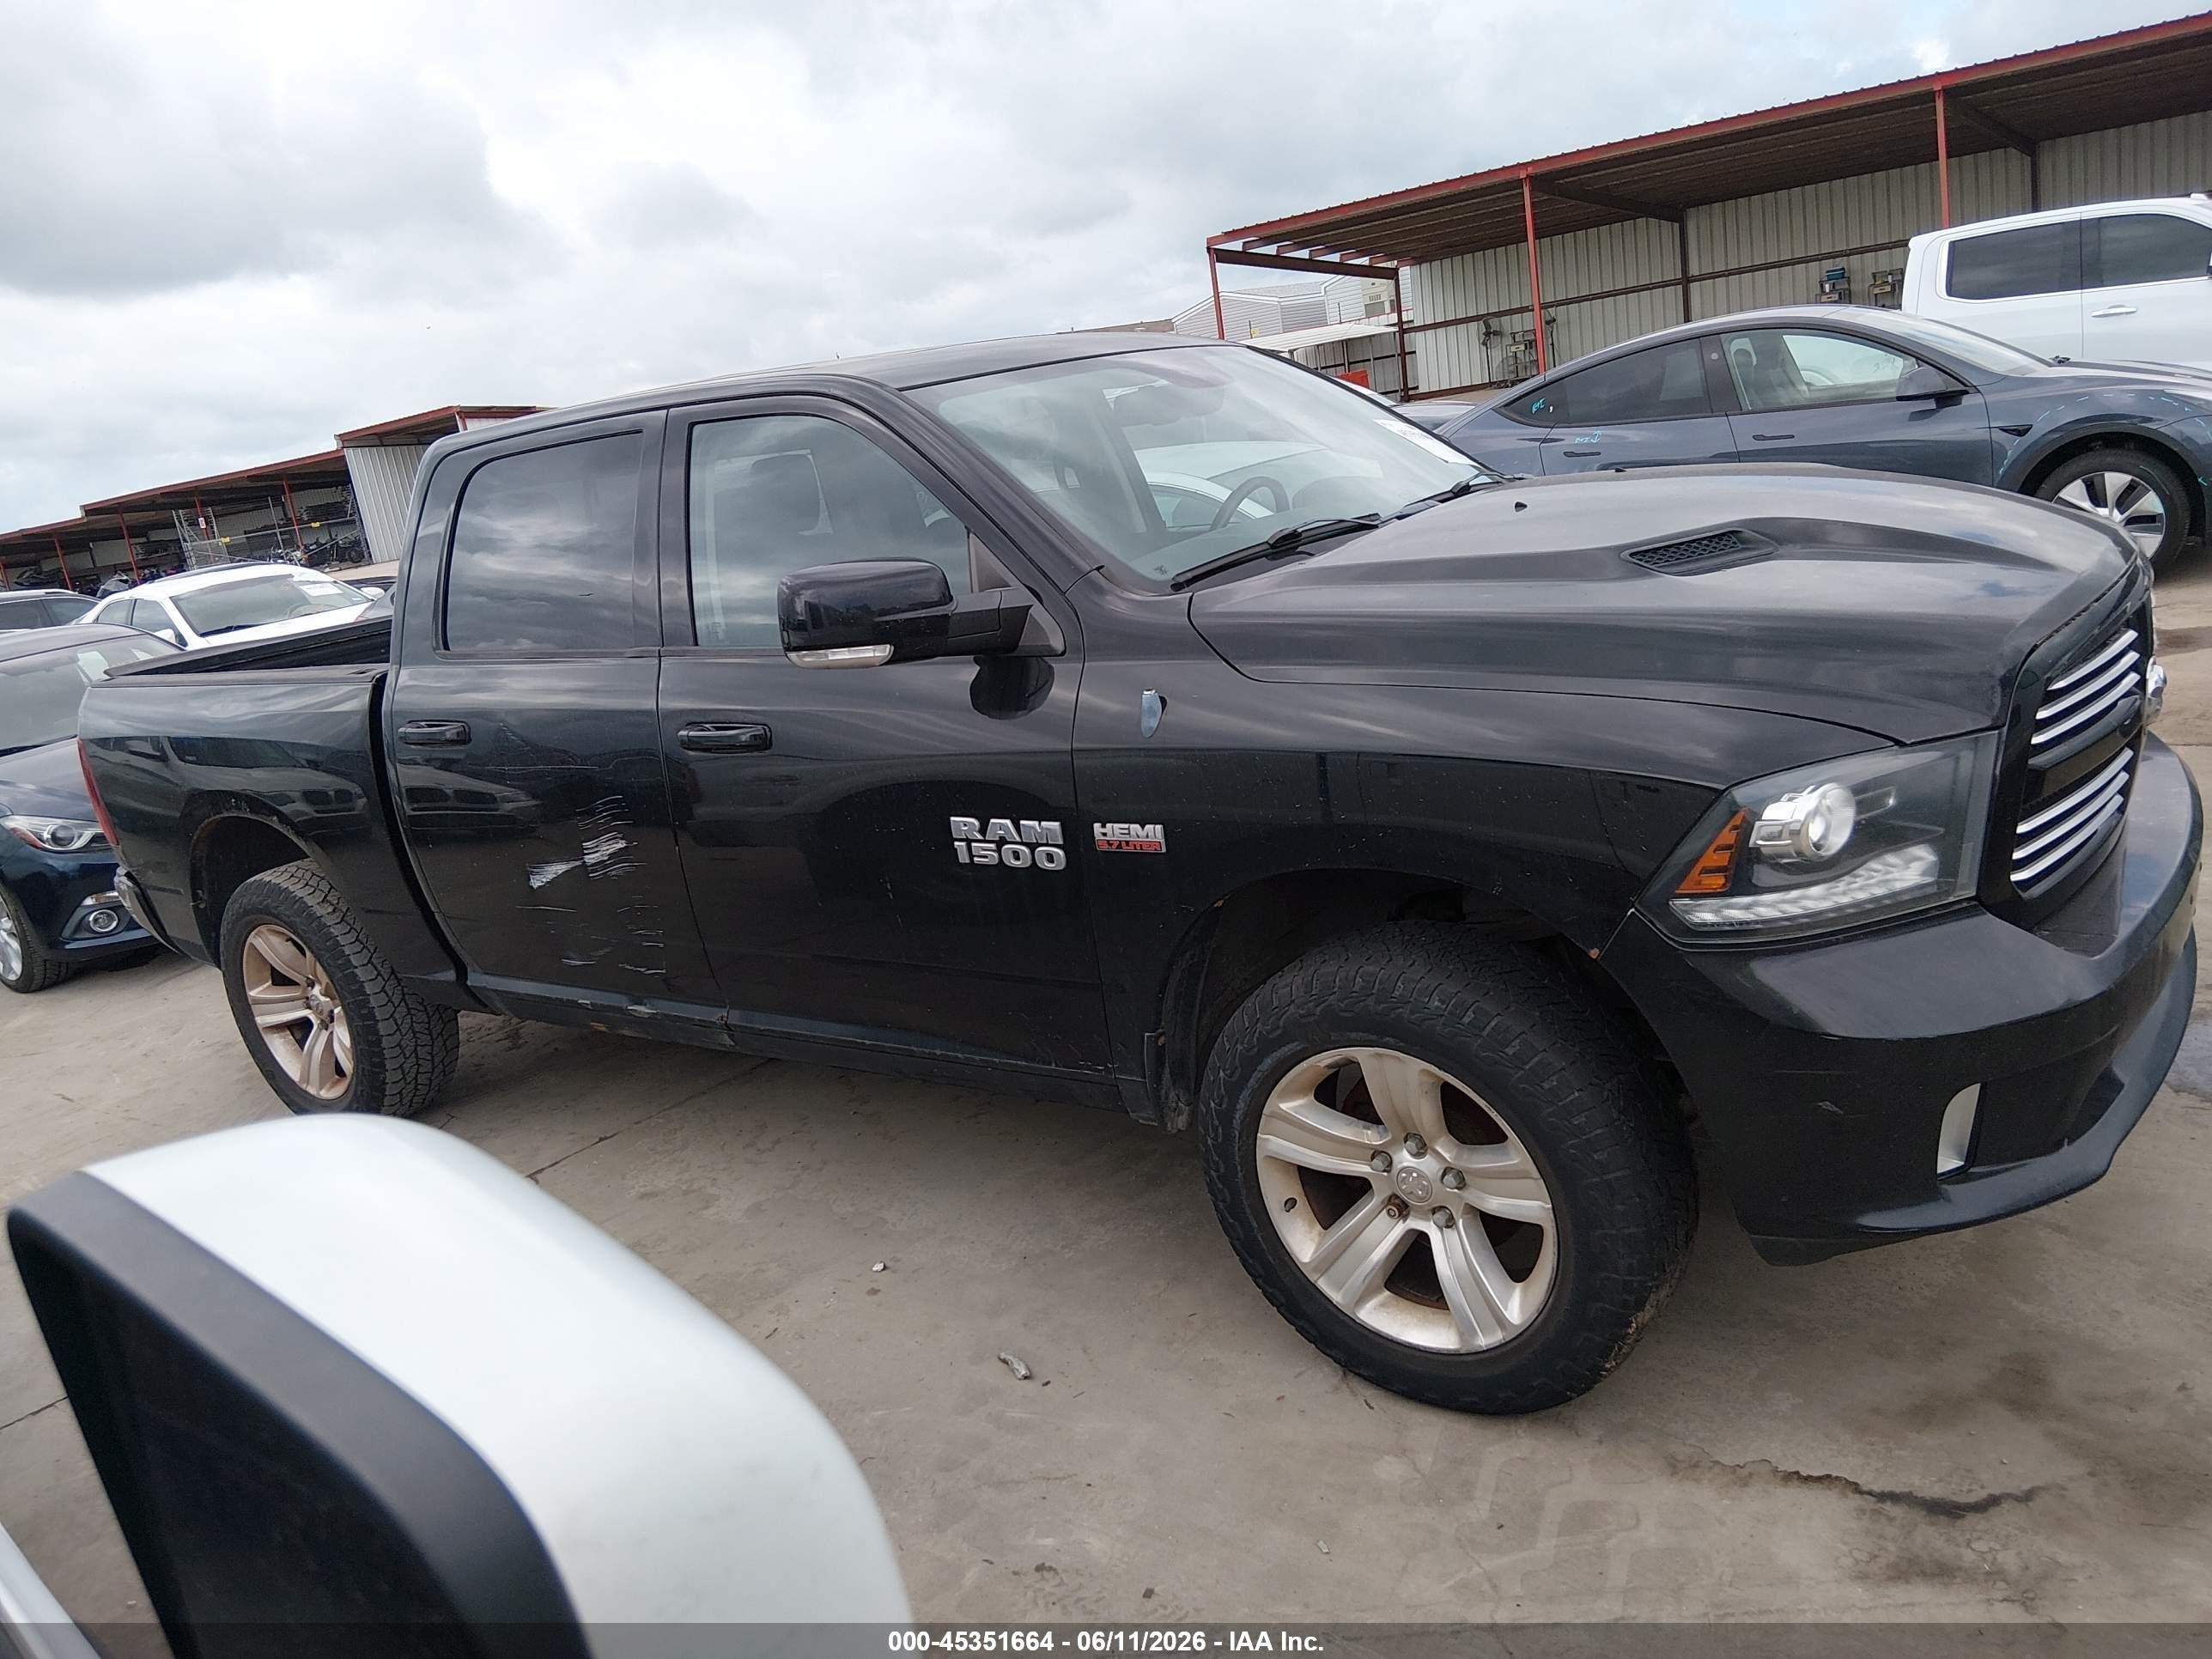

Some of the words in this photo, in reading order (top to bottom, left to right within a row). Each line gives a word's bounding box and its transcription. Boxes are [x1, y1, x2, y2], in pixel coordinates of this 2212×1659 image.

[950, 817, 1064, 844] RAM
[1093, 823, 1164, 839] HEMI
[954, 842, 1067, 870] 1500
[1097, 840, 1120, 850] 5.7
[1121, 841, 1162, 851] LITER
